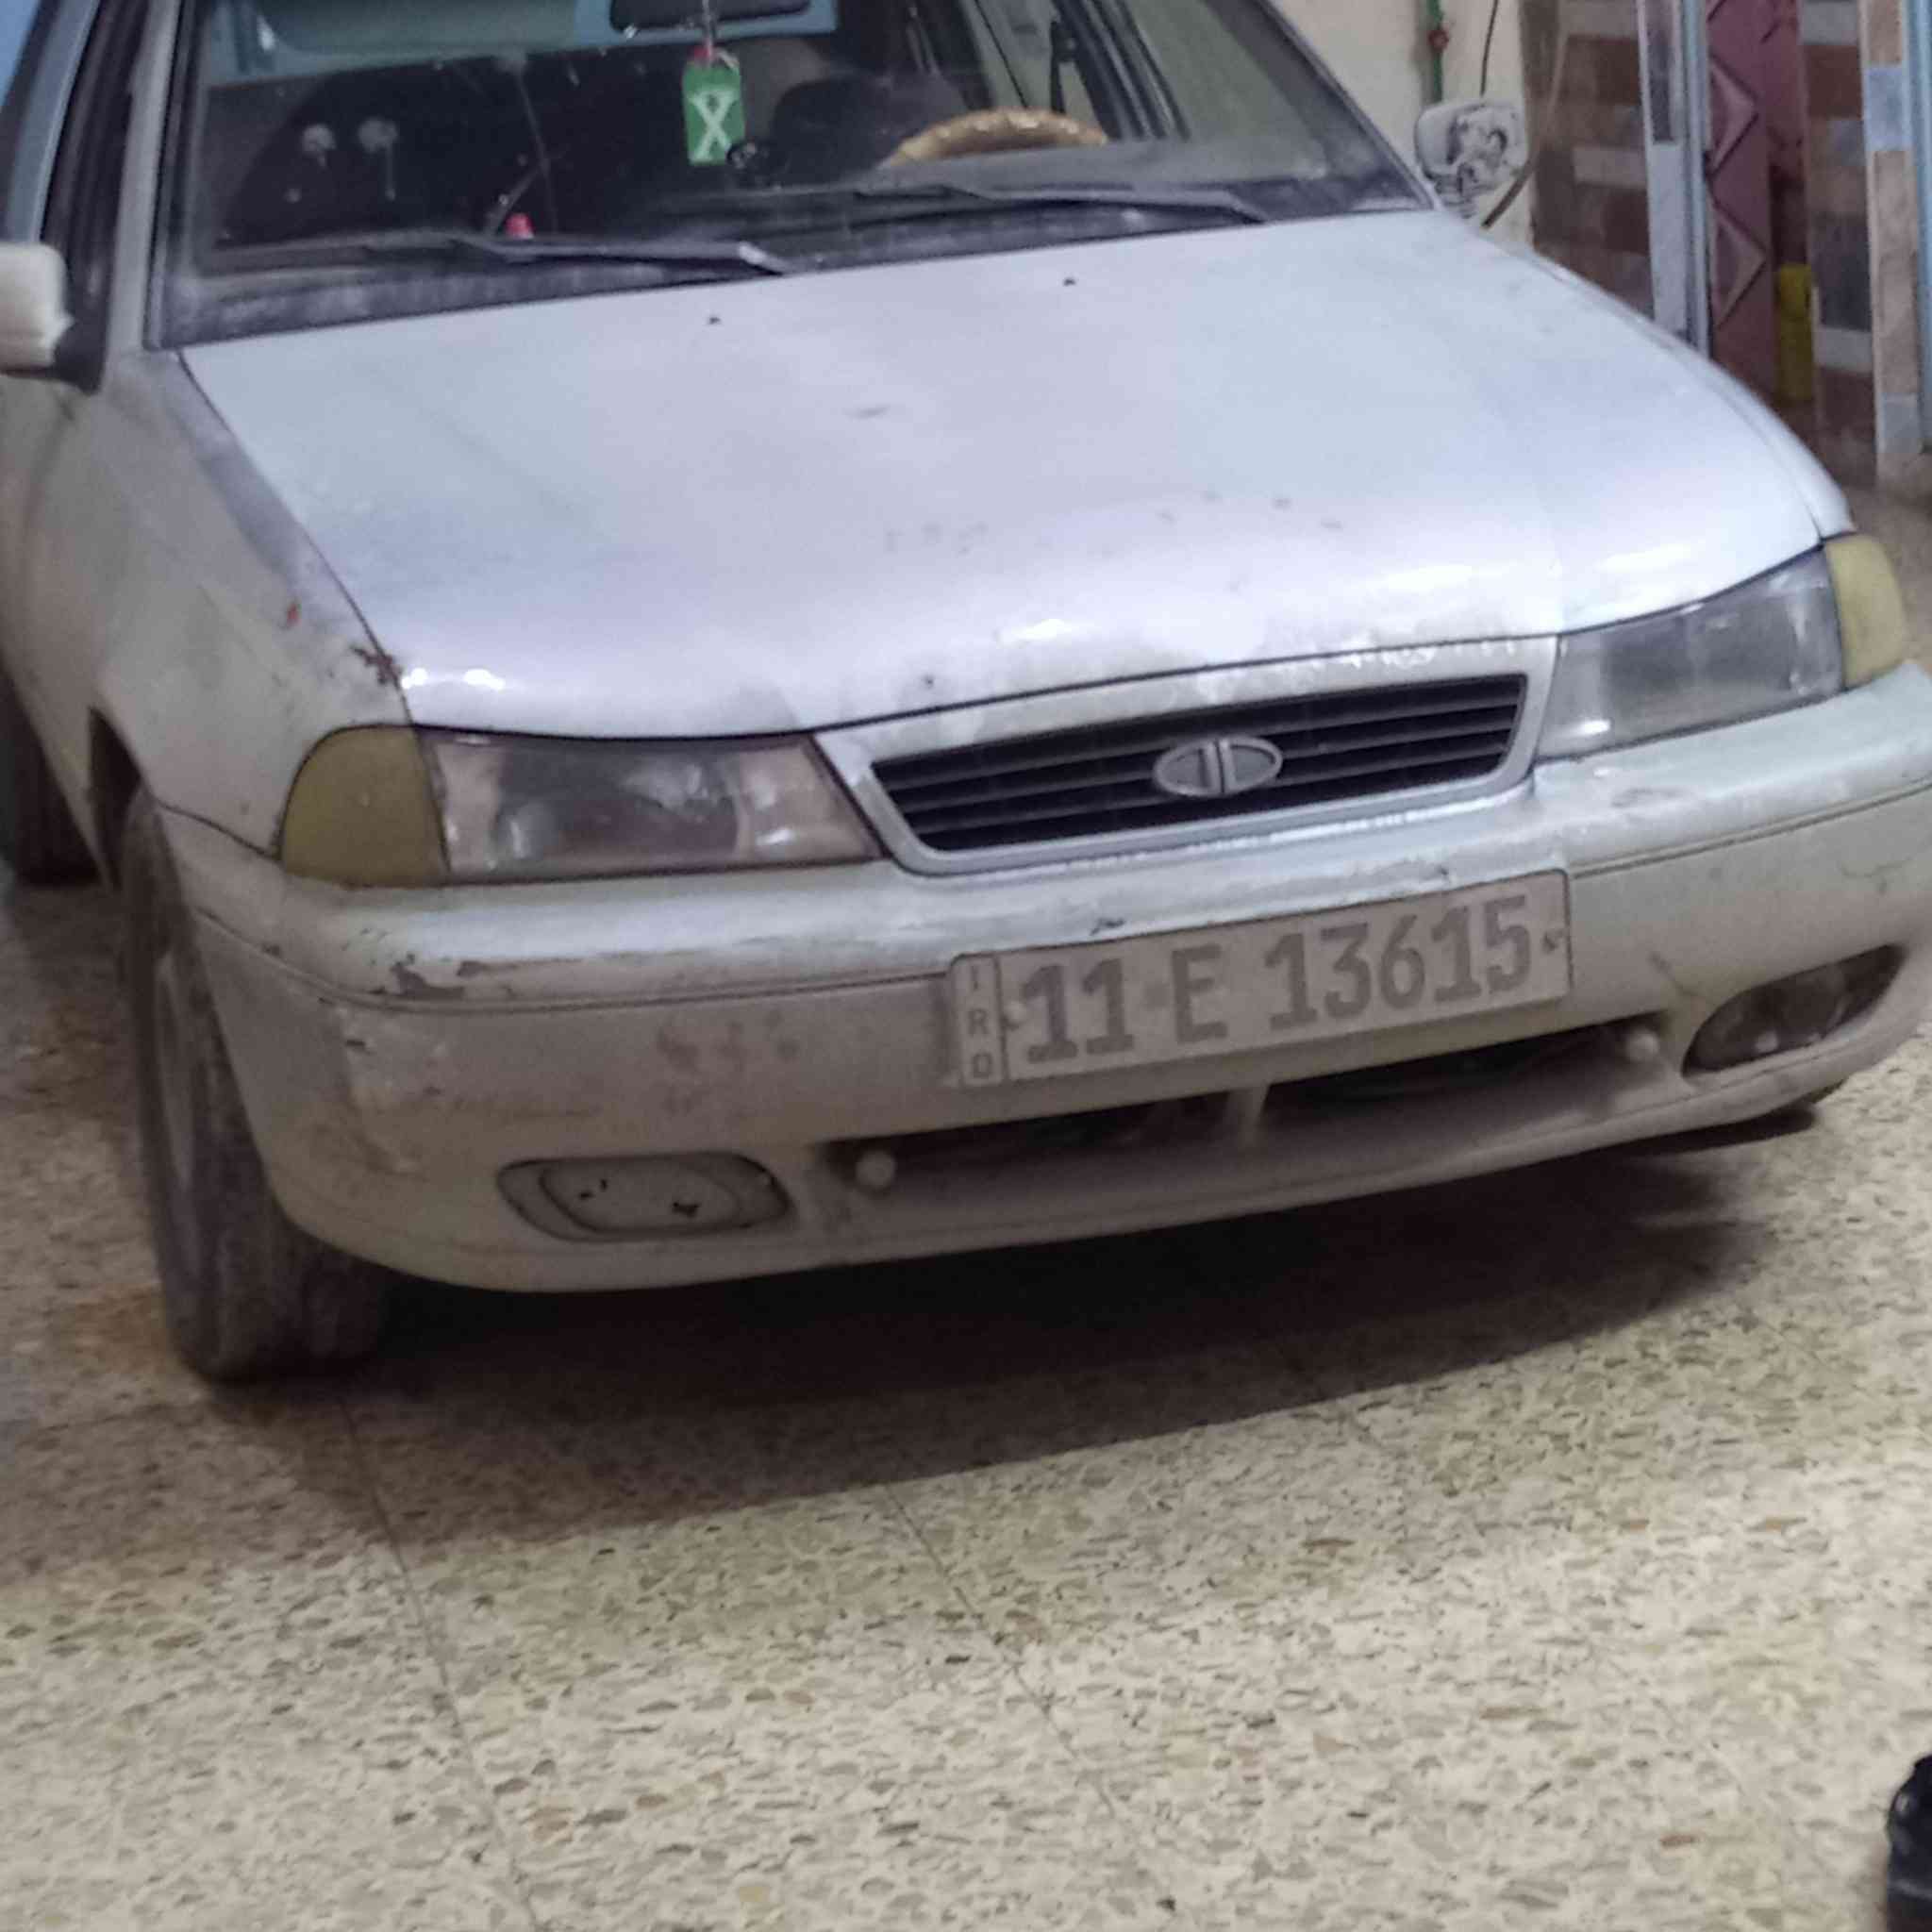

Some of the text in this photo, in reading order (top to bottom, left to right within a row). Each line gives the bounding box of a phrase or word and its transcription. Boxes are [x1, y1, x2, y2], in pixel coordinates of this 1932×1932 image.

[1022, 895, 1530, 1063] 11 E 13615
